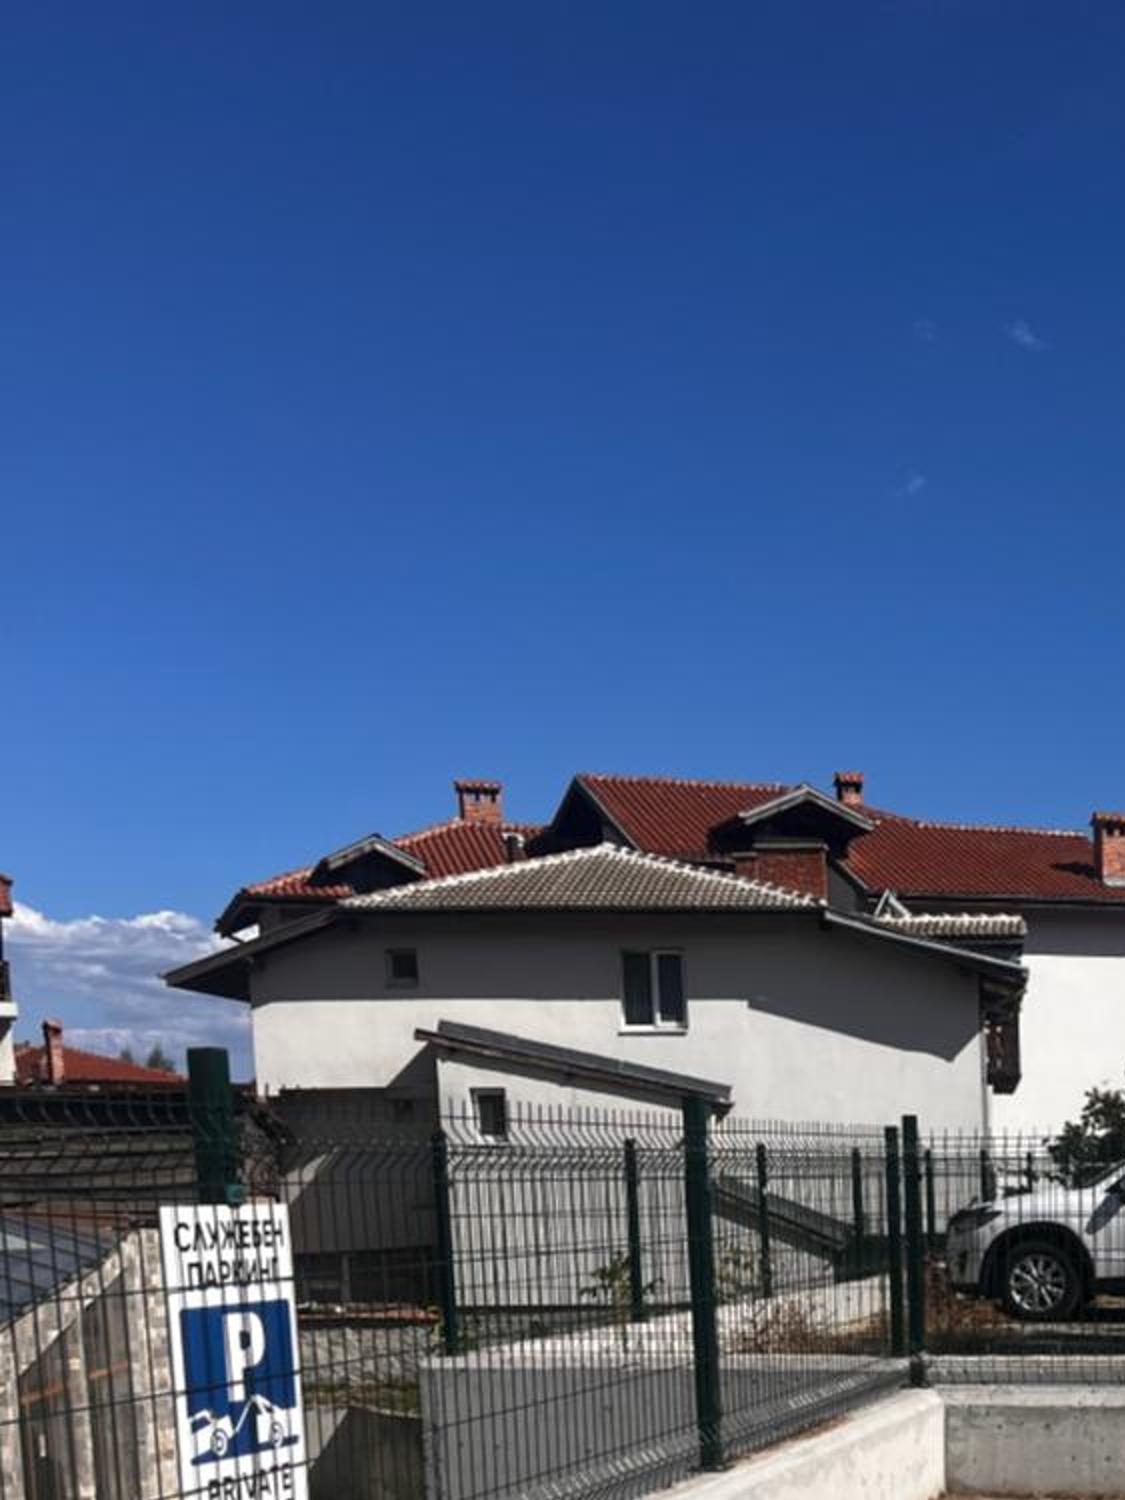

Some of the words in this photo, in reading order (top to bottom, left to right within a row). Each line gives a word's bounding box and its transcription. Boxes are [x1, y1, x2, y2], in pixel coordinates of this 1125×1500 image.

[174, 1219, 284, 1252] СЛУЖЕБЕН
[187, 1257, 279, 1289] ПАРКИНГ
[225, 1311, 265, 1402] P
